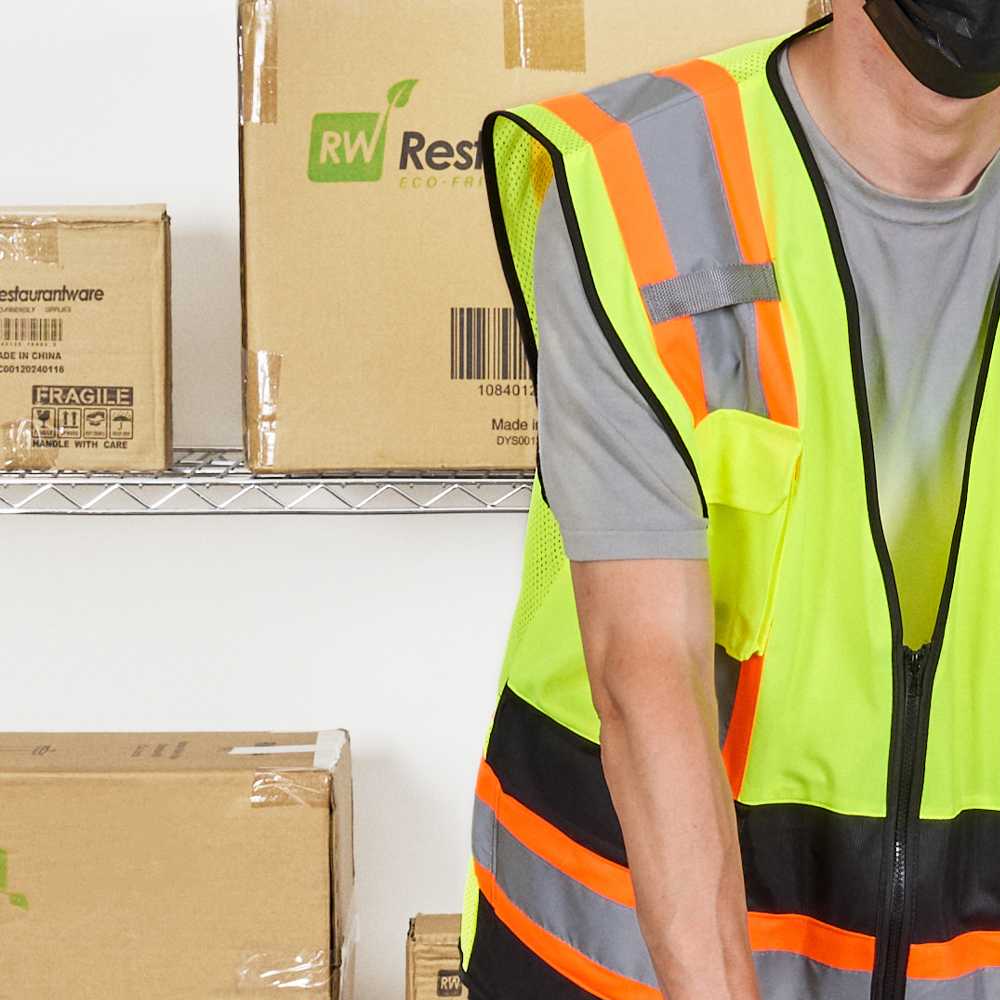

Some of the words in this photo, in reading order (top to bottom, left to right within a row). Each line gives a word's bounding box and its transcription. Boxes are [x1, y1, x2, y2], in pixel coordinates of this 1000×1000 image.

[319, 130, 380, 165] RW
[19, 352, 29, 360] IN
[32, 352, 62, 360] CHINA
[36, 387, 130, 404] FRAGILE
[491, 418, 528, 430] Made
[32, 440, 69, 448] HANDLE
[104, 441, 128, 449] CARE
[441, 976, 461, 990] RW
